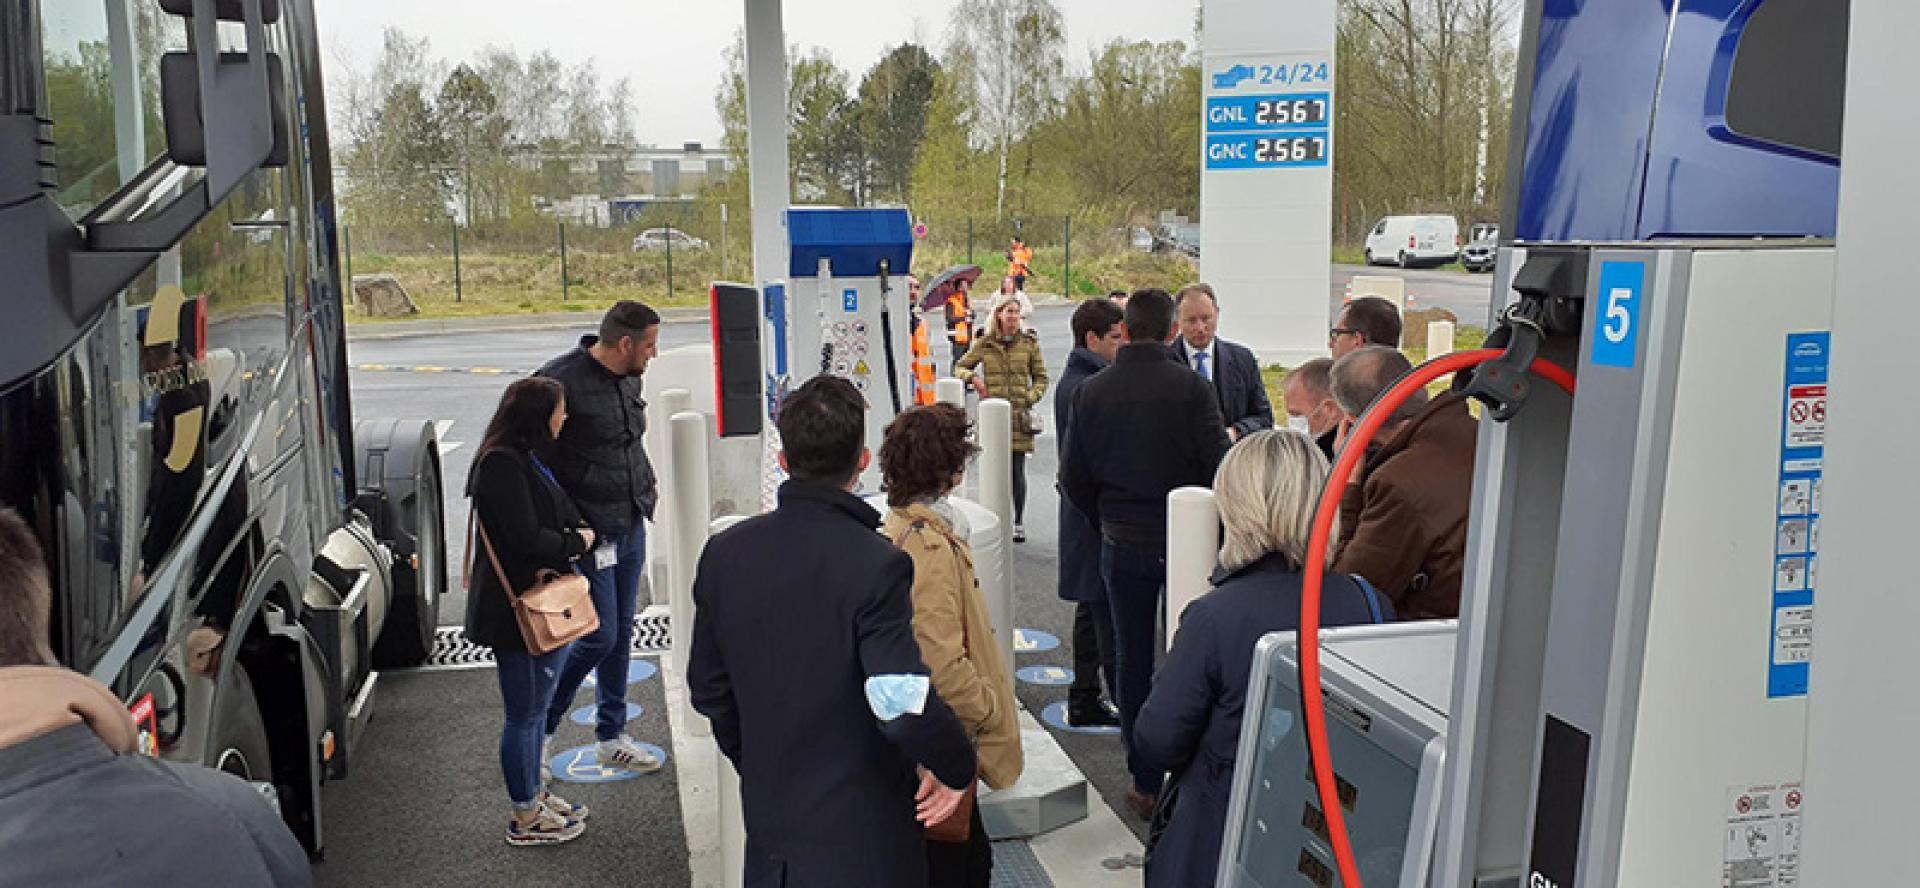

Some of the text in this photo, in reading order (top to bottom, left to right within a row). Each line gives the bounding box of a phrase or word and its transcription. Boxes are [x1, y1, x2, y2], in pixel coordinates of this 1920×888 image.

[1259, 62, 1328, 84] 24/24
[1209, 100, 1326, 125] GNL 2.567
[1209, 137, 1325, 161] GNC 2.567
[1603, 287, 1633, 343] 5
